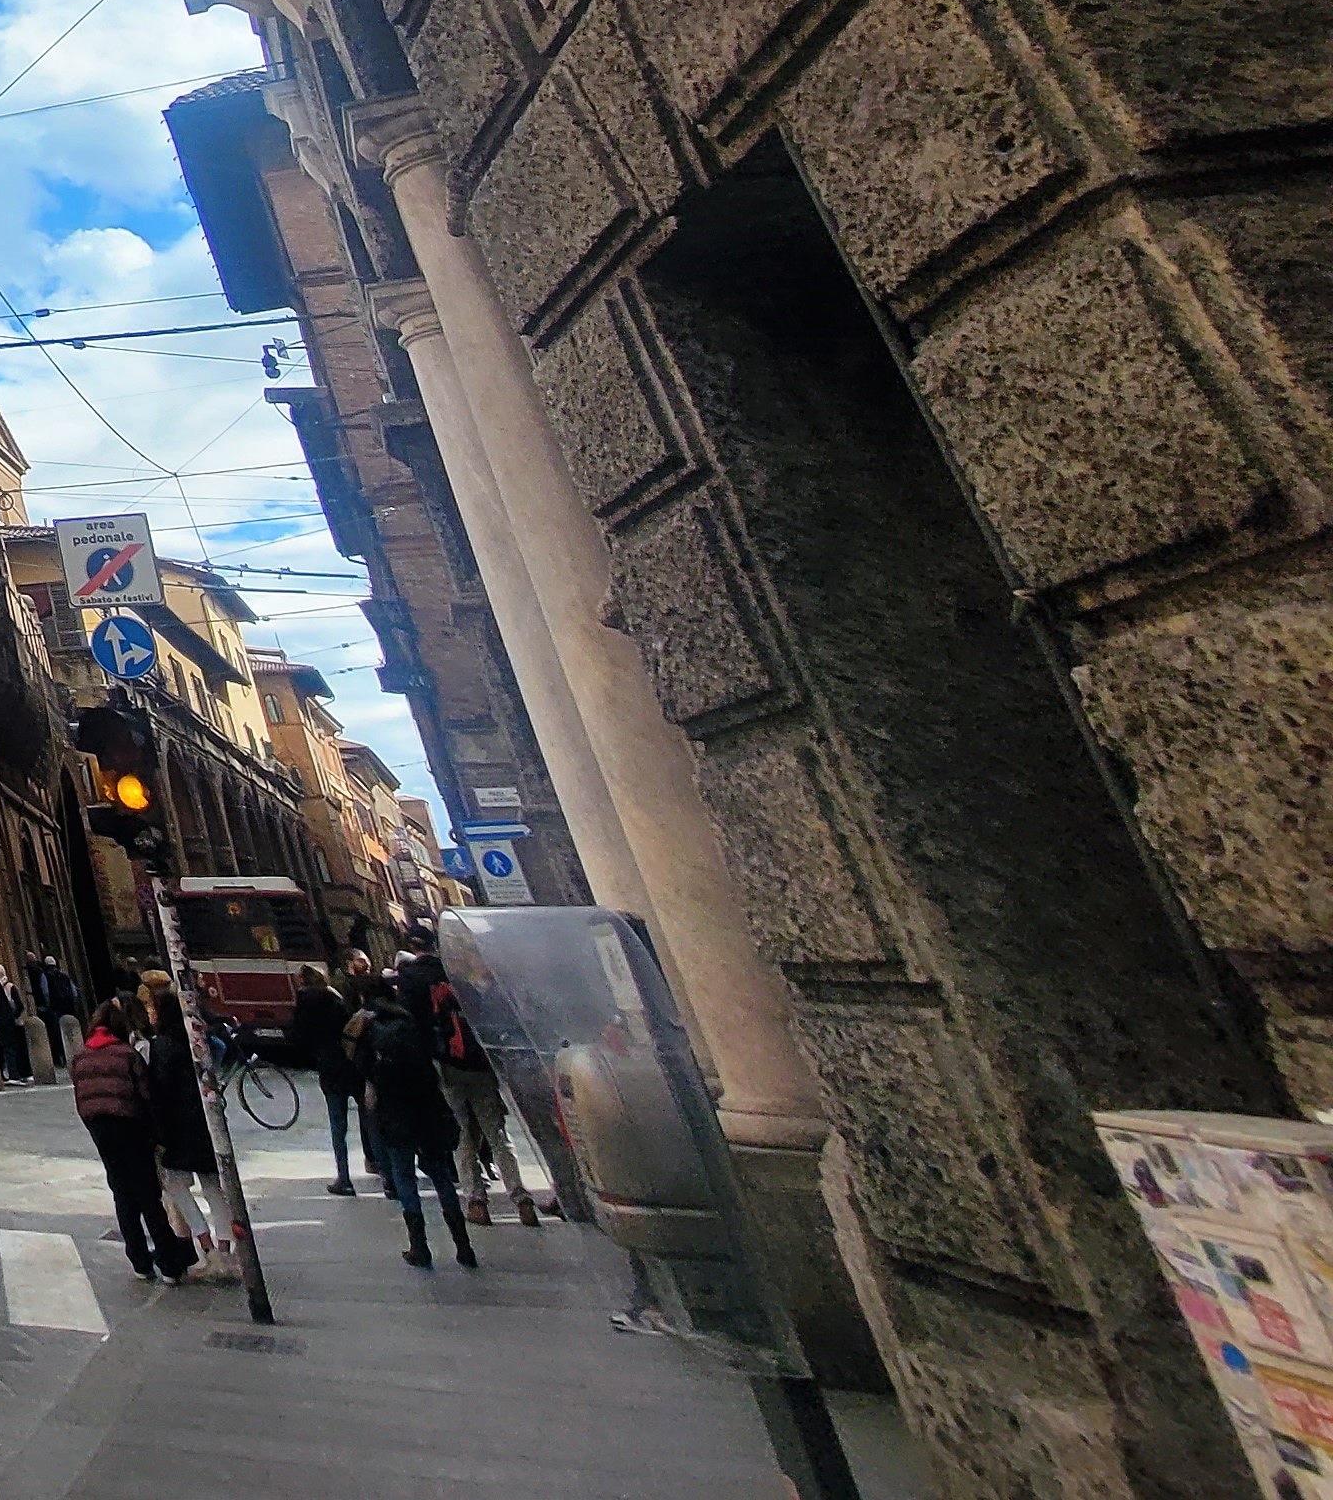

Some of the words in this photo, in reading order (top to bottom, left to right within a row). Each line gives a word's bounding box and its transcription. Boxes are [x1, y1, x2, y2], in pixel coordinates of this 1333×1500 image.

[86, 520, 115, 531] area
[72, 531, 134, 547] pedonale
[79, 595, 111, 605] Sabato
[122, 593, 154, 602] festivi
